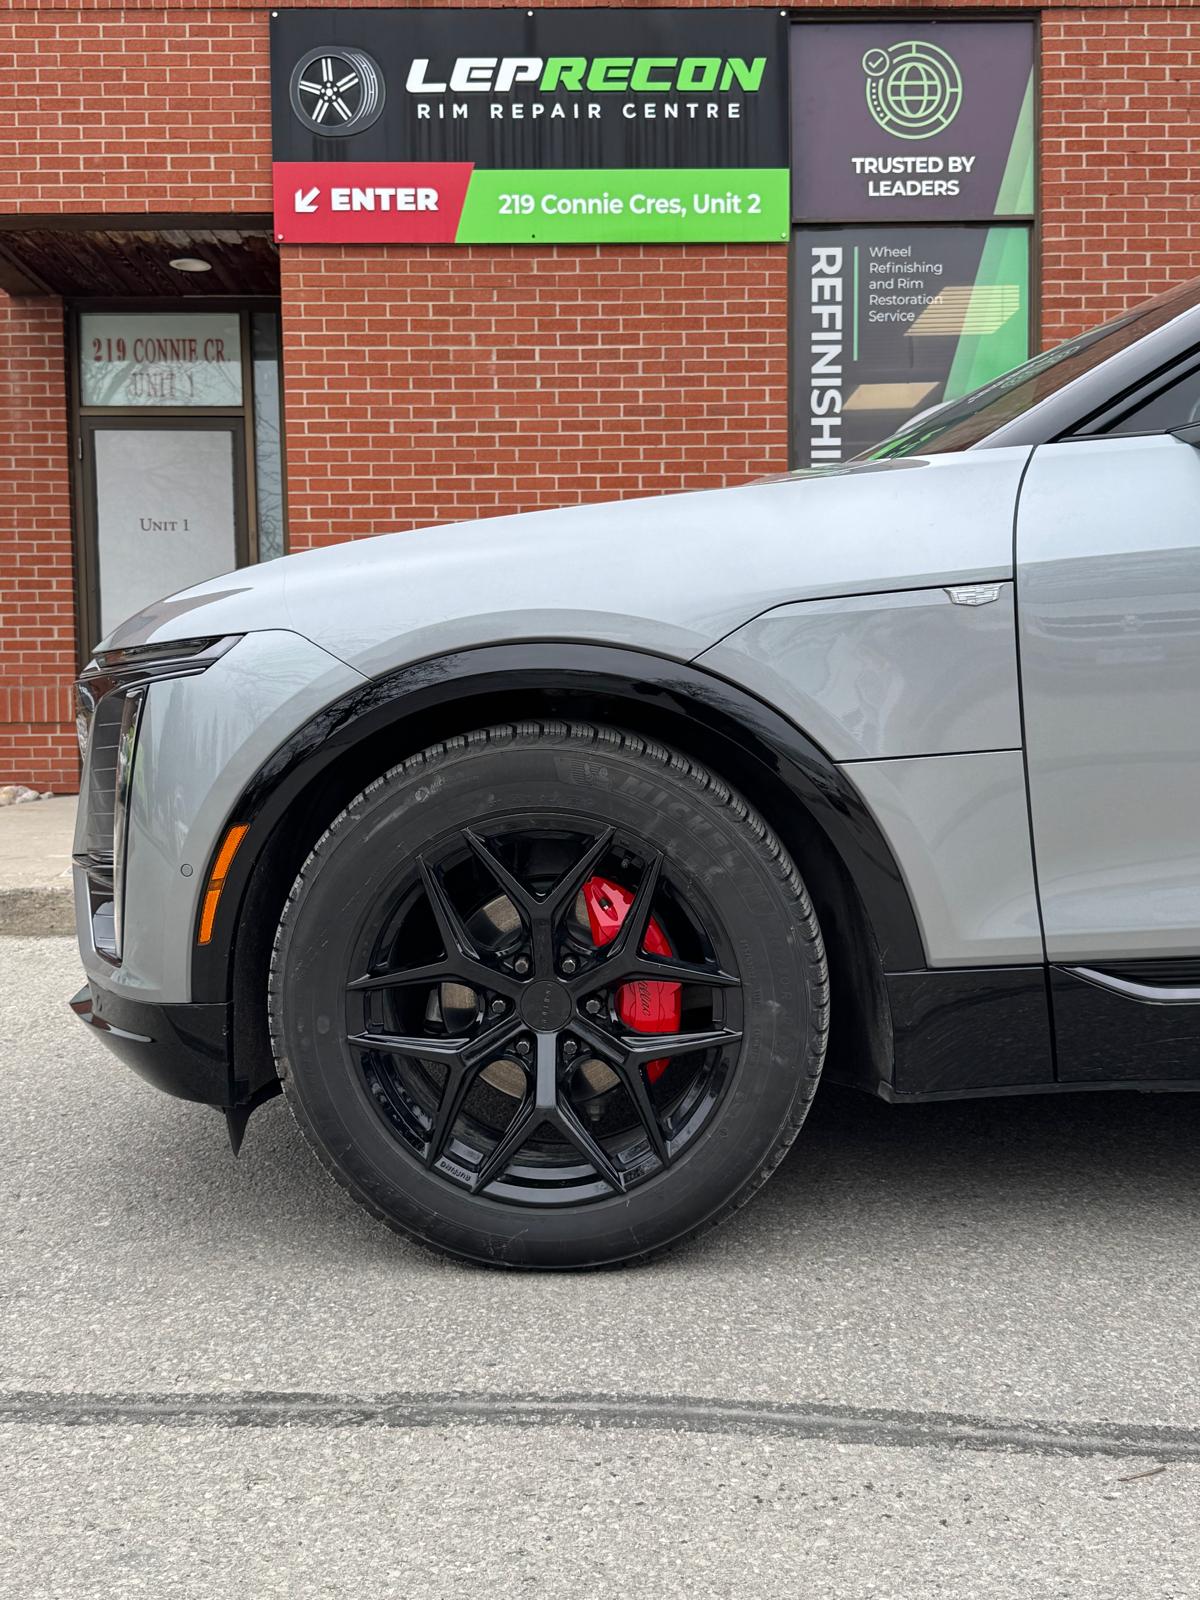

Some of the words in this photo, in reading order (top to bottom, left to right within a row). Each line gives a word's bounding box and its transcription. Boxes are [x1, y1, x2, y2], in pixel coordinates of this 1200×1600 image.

[405, 57, 767, 93] LEPRECON
[417, 102, 469, 119] RIM
[490, 102, 602, 119] REPAIR
[622, 102, 741, 119] CENTRE
[851, 156, 944, 174] TRUSTED
[948, 155, 976, 173] BY
[867, 179, 960, 197] LEADERS
[330, 187, 440, 212] ENTER
[498, 194, 536, 215] 219
[540, 193, 624, 215] Connie
[628, 193, 687, 218] Cres,
[692, 192, 742, 215] Unit
[747, 193, 762, 214] 2
[868, 245, 912, 258] Wheel
[868, 261, 943, 277] Refinishing
[868, 277, 895, 291] and
[896, 277, 924, 291] Rim
[868, 292, 944, 306] Restoration
[868, 309, 916, 323] Service
[92, 337, 127, 363] 219
[133, 337, 199, 364] CONNIE
[810, 247, 843, 468] REFINISHI
[182, 517, 190, 532] 1
